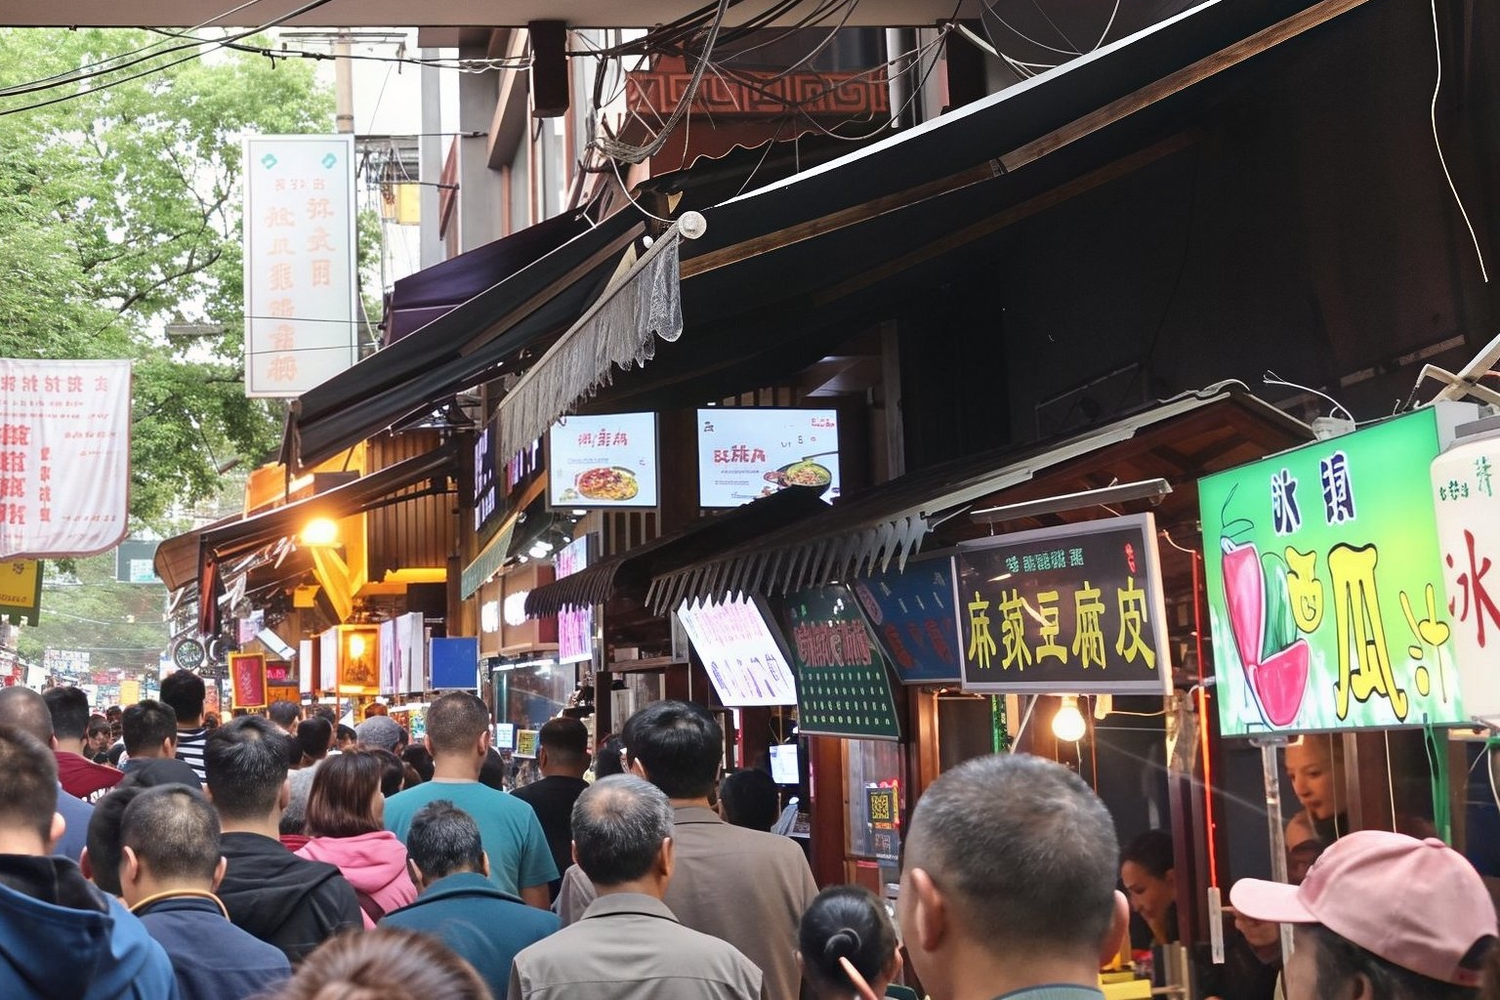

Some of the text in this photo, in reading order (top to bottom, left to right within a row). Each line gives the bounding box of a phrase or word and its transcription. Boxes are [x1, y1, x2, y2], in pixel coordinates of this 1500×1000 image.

[968, 576, 1156, 671] 麻辣豆腐皮
